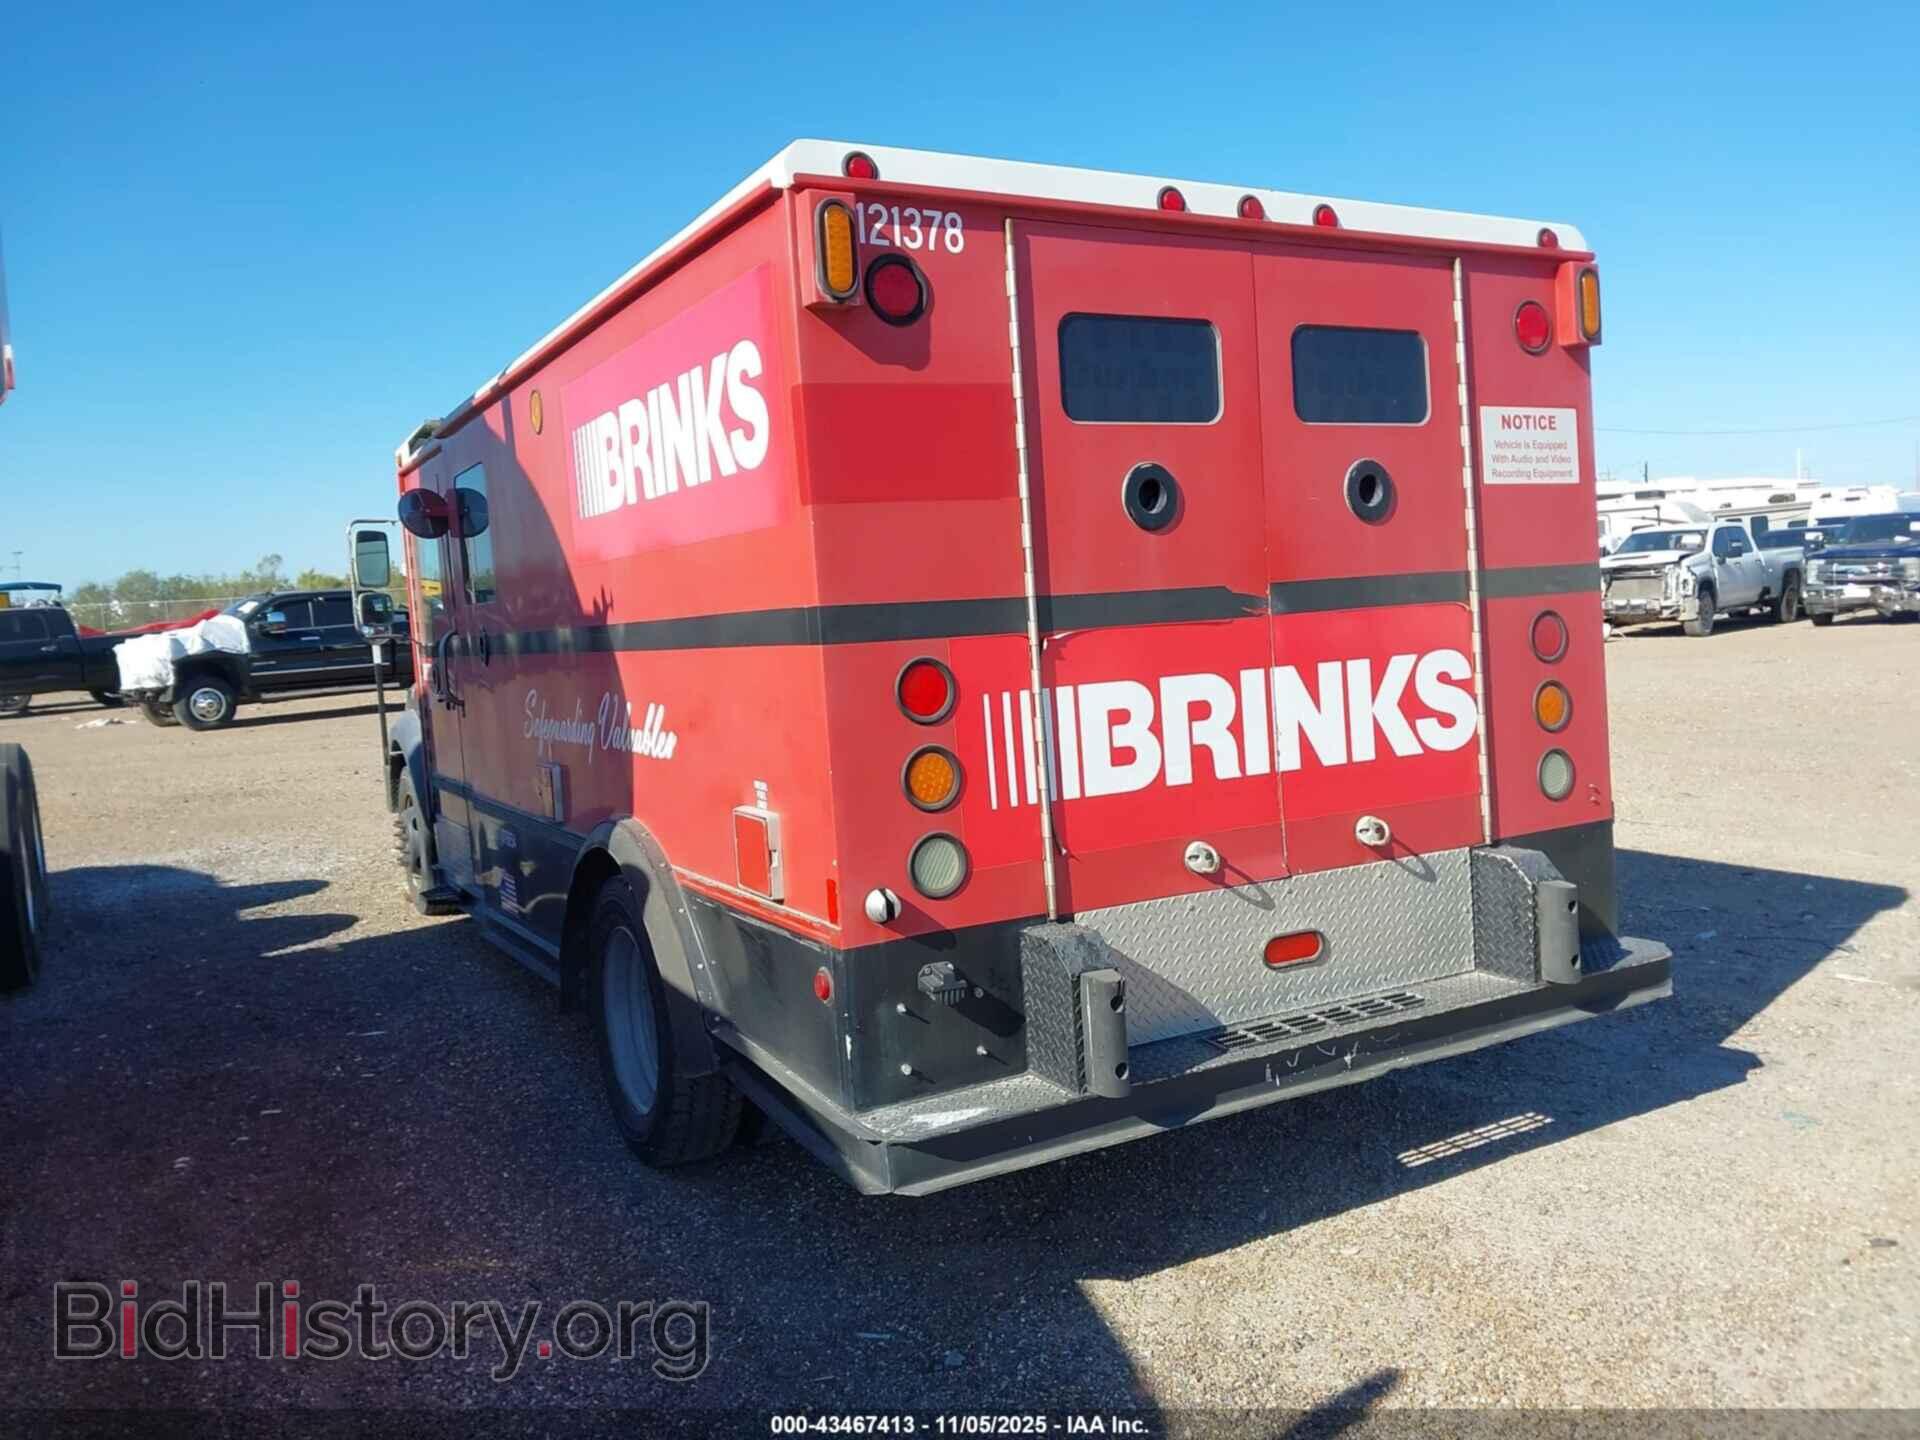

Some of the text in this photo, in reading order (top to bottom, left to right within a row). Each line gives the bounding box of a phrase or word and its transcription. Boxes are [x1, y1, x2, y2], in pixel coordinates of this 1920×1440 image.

[855, 202, 964, 254] 121378
[595, 339, 769, 513] BRINKS
[1501, 414, 1557, 431] NOTICE
[1491, 454, 1572, 464] With Audio and Video
[1494, 440, 1522, 449] Vehicle
[1532, 440, 1568, 452] Equipped
[1492, 469, 1574, 480] Recording Equipment
[523, 688, 678, 765] Safeguarding Valuables
[1076, 649, 1479, 799] BRINKS
